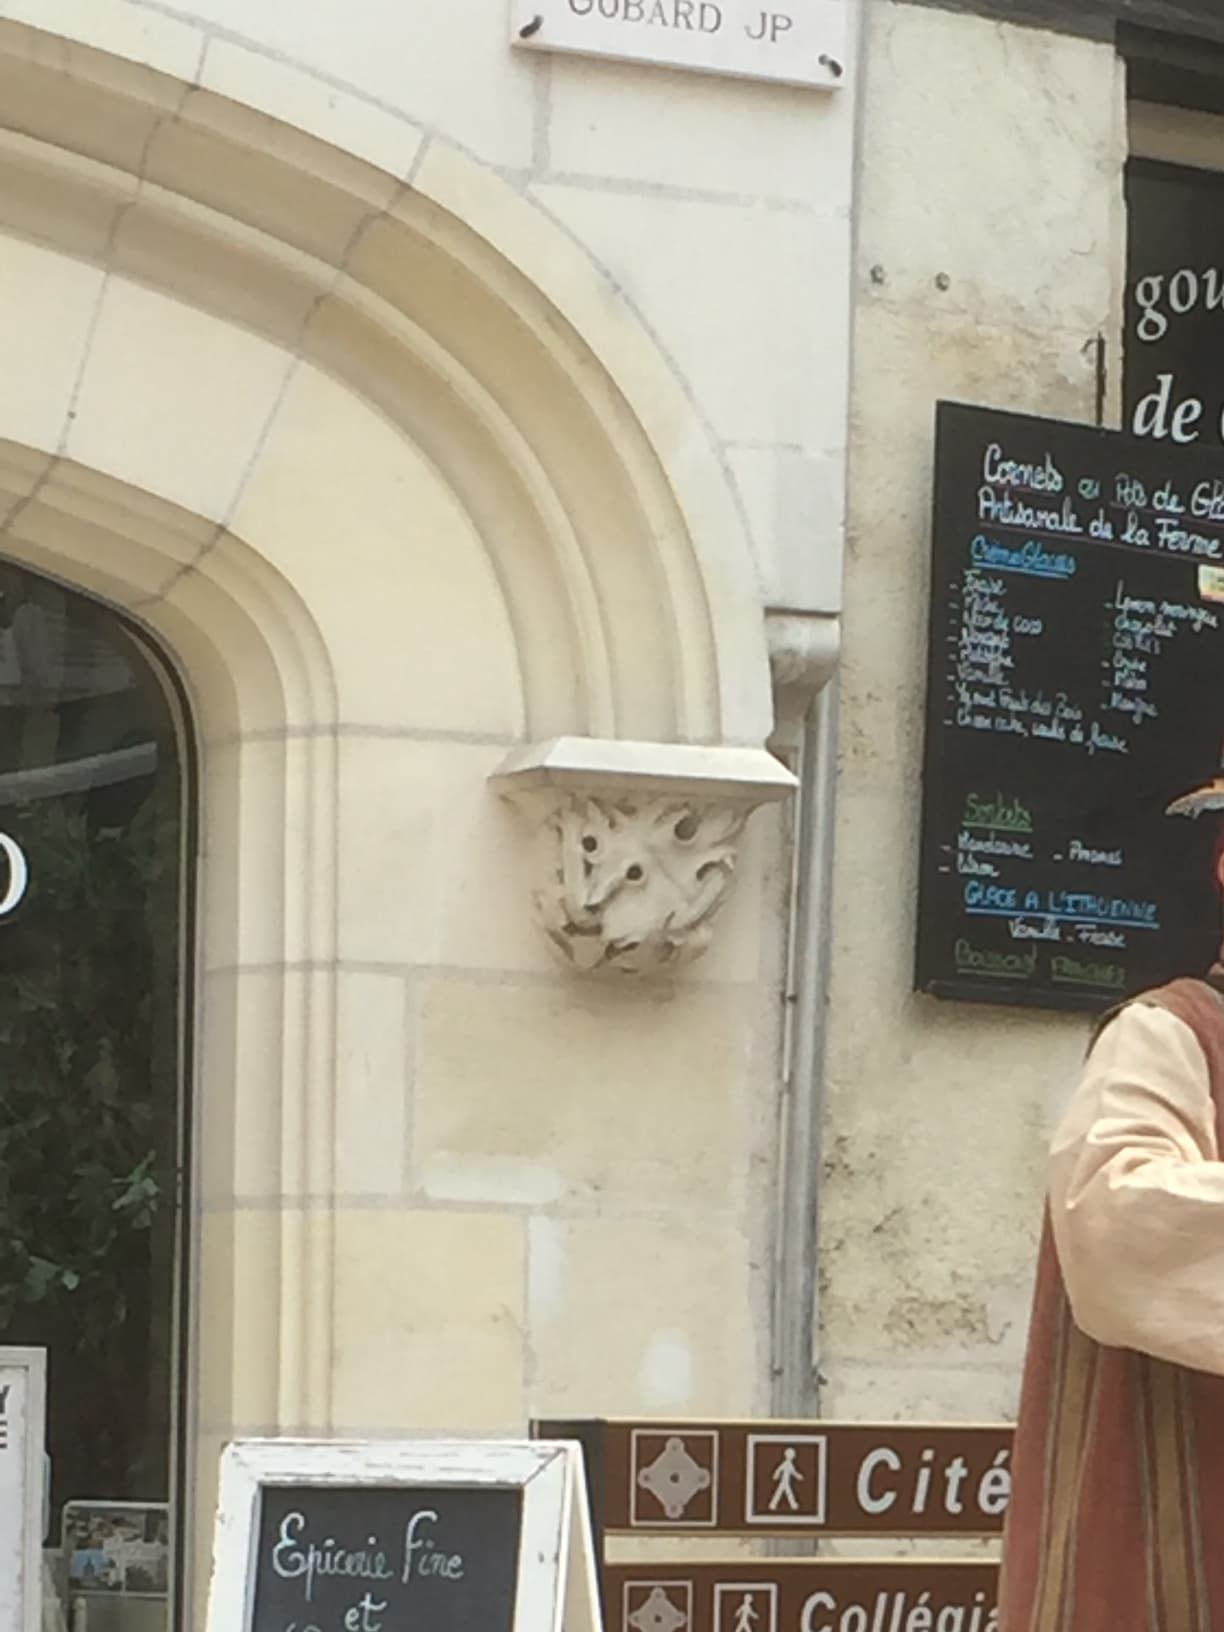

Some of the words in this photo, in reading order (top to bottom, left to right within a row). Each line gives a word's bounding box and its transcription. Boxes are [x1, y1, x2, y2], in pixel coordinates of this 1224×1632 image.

[744, 11, 794, 42] JP
[1133, 374, 1201, 443] de
[1152, 480, 1185, 513] de
[1089, 507, 1114, 540] de
[1120, 508, 1151, 545] la
[1155, 517, 1223, 559] Ferme
[1024, 889, 1040, 910] A
[856, 1447, 1012, 1515] Cité
[344, 1592, 388, 1632] et
